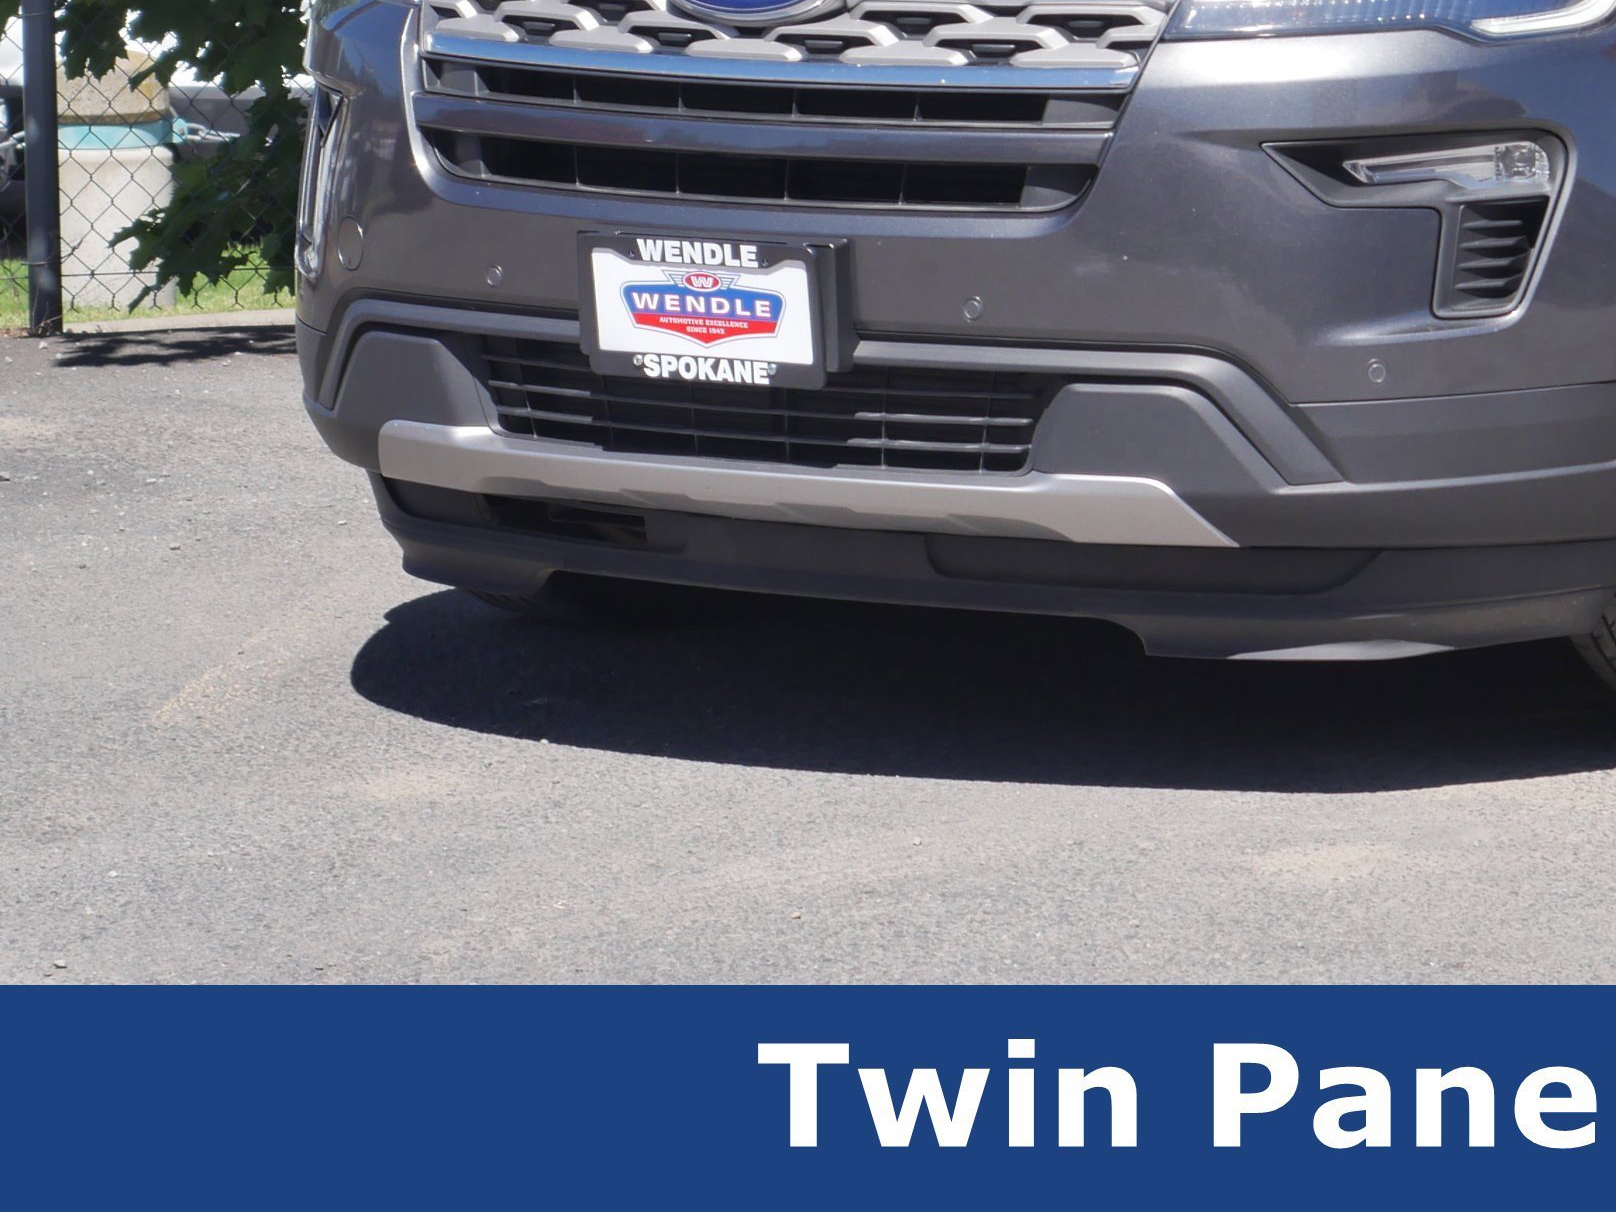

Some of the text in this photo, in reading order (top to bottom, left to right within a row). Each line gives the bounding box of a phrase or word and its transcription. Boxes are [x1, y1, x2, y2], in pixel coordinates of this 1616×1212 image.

[635, 238, 759, 268] WENDLE
[632, 292, 772, 318] WENDLE
[659, 316, 749, 329] AUTOMOTIVE EXCELLENCE
[643, 354, 770, 385] SPOKANE
